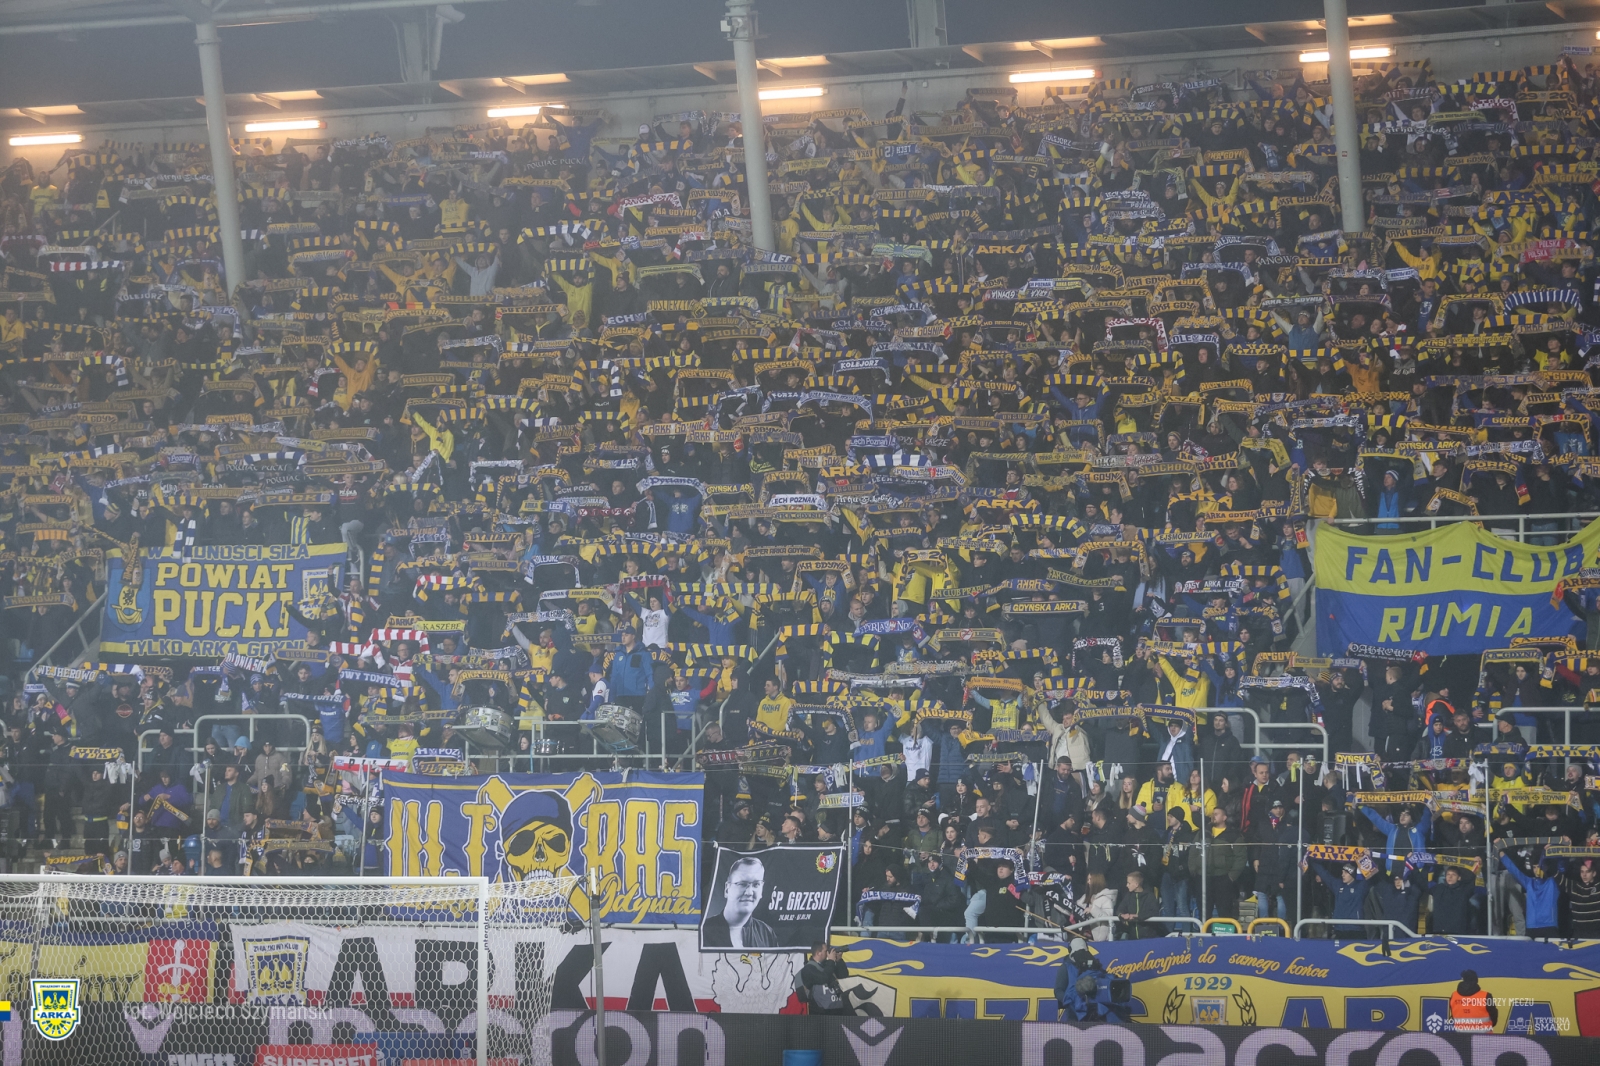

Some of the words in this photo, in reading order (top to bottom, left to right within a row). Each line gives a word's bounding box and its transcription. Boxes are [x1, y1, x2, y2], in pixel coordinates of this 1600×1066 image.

[1046, 135, 1072, 149] OLEJORZ
[1377, 218, 1403, 227] SMOND
[975, 244, 1026, 254] ARKA
[771, 253, 791, 263] LEC
[744, 263, 793, 273] OŚCICINO
[608, 315, 626, 324] ECH
[1171, 335, 1191, 344] OLE
[1200, 334, 1218, 342] JOR
[840, 358, 880, 369] KOLEJORZ
[266, 408, 309, 416] MRZEZIN
[29, 420, 74, 429] RZEZIN
[93, 423, 143, 432] RZEZINO
[1399, 442, 1433, 450] DYŃSKA
[821, 466, 869, 476] ARKA
[821, 466, 870, 477] ARKA
[557, 487, 571, 495] ECH
[265, 493, 316, 504] PUCK
[976, 500, 1038, 509] ARKA
[1192, 531, 1213, 540] PARK
[148, 547, 163, 560] W
[173, 546, 262, 561] DNOŚCI
[269, 544, 311, 559] SIŁA
[1345, 542, 1584, 584] FAN-CLUB
[155, 563, 294, 588] POWIAT
[623, 575, 665, 587] DYNI
[1204, 580, 1222, 588] ARKA
[932, 588, 942, 598] AN
[943, 587, 960, 597] CLUB
[1013, 602, 1049, 611] GDYŃSKA
[1052, 601, 1077, 610] ARKA
[152, 590, 294, 638] PUCKI
[1377, 602, 1534, 643] RUMIA
[126, 640, 183, 657] TYLKO
[190, 641, 240, 657] ARKA
[247, 641, 307, 657] GDYNI
[228, 653, 252, 670] OLONIA
[38, 666, 96, 682] WEJHEROWO
[340, 670, 360, 681] OWY
[1080, 707, 1115, 717] ZWIĄZKOWY
[1117, 707, 1131, 715] KLUB
[1536, 746, 1600, 758] ARKA
[1336, 754, 1373, 763] DYŃSKA
[420, 762, 465, 773] ULTRA
[1360, 794, 1388, 802] ARKA
[1390, 793, 1426, 802] GDYNIA
[1309, 845, 1365, 860] ARKA
[769, 887, 782, 911] ŚP.
[786, 891, 832, 910] GRZESIU
[596, 884, 698, 926] Gdynia
[1198, 945, 1218, 966] do
[1229, 953, 1280, 975] samego
[1284, 956, 1330, 979] końca
[1184, 976, 1233, 991] 1929
[1279, 995, 1562, 1034] ARA
